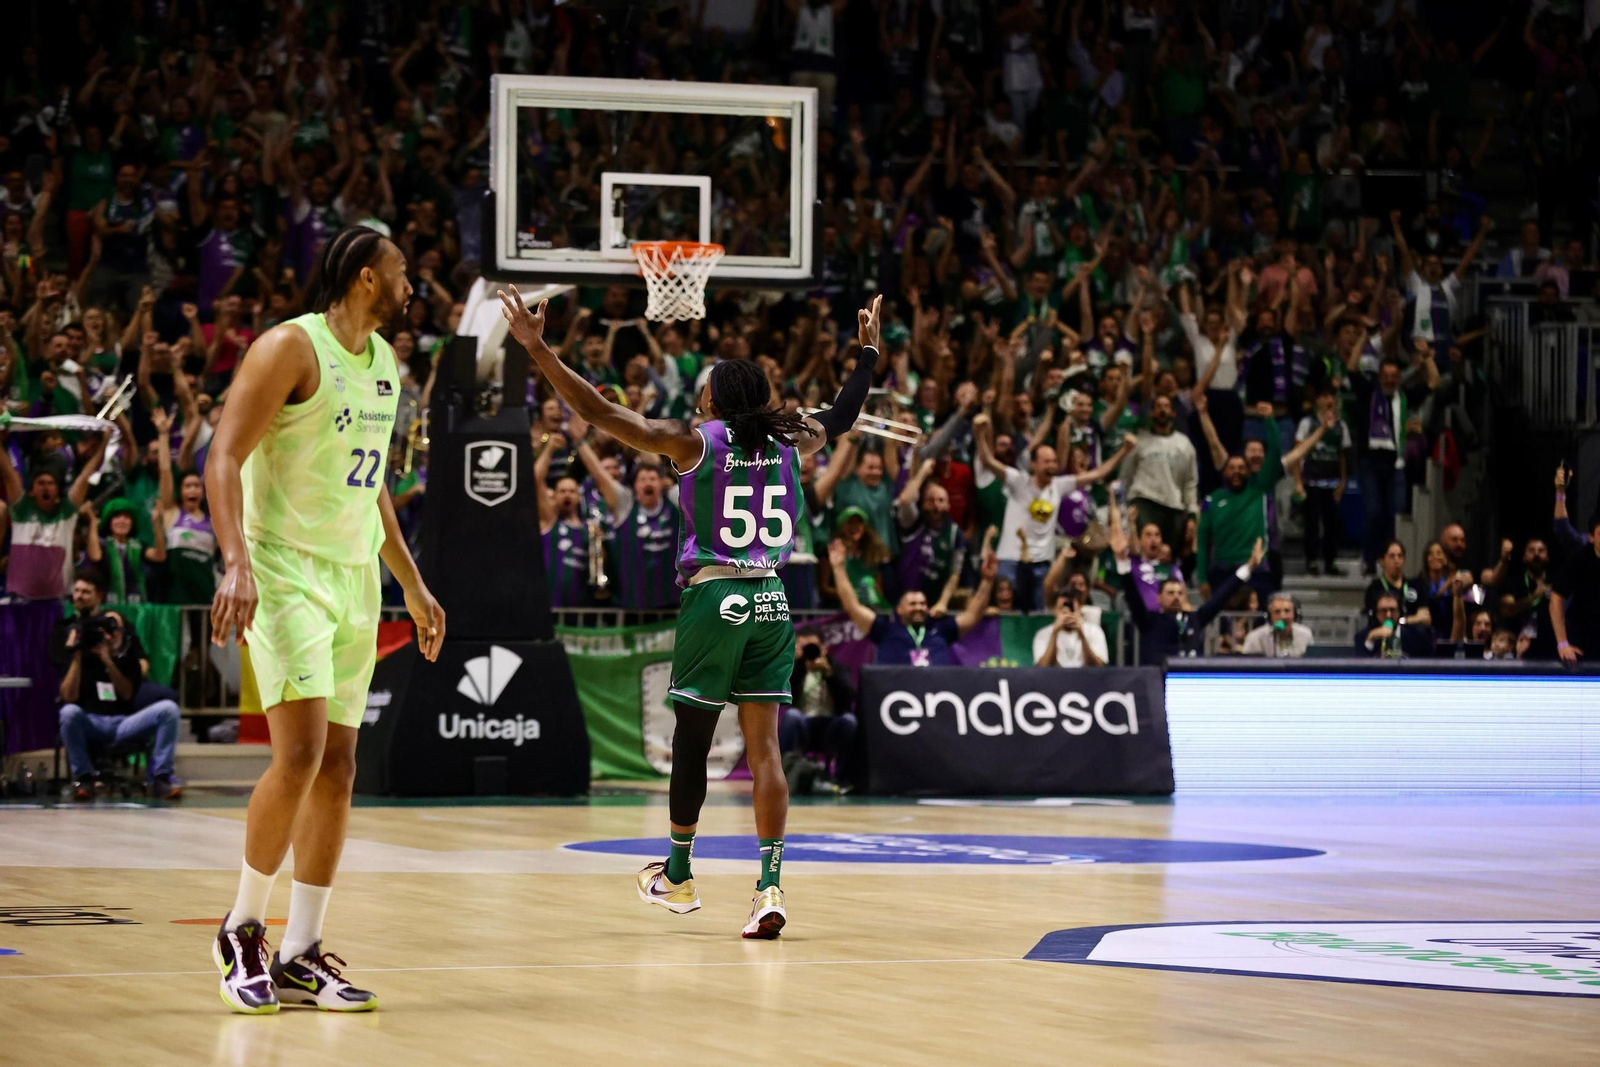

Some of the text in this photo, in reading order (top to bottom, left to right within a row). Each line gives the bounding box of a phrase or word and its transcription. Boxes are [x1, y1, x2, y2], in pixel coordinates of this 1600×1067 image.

[346, 448, 381, 488] 22
[719, 485, 793, 549] 55
[754, 603, 775, 614] DEL
[438, 712, 541, 747] Unicaja
[879, 678, 1139, 736] endesa
[1216, 931, 1600, 986] Baloncest
